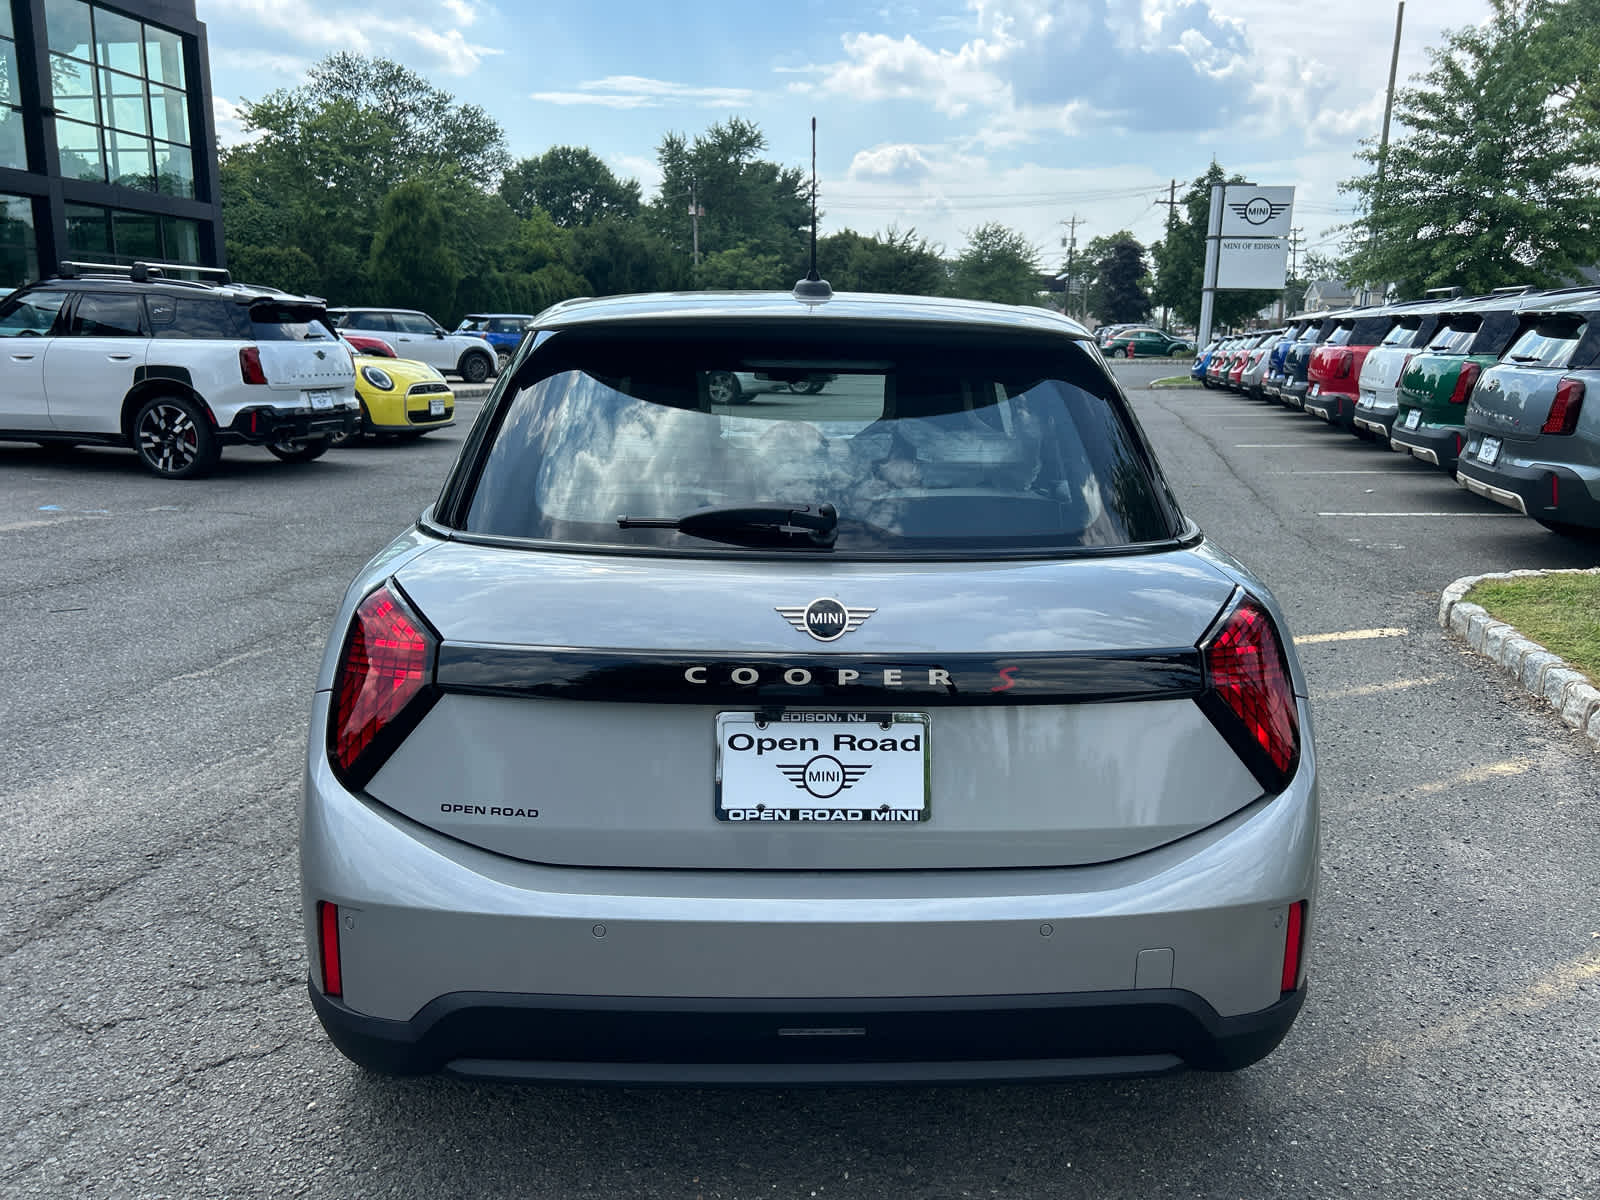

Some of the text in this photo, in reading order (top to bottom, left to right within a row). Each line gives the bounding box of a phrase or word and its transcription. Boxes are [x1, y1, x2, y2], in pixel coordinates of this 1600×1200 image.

[1248, 207, 1269, 216] MINI
[1223, 242, 1281, 250] MINI OF EDISON
[809, 612, 844, 625] MINI
[684, 666, 1020, 692] COOPER S
[781, 712, 867, 723] EDISON, NJ
[727, 733, 921, 755] Open Road
[808, 770, 840, 783] MINI
[440, 803, 539, 818] OPEN ROAD
[728, 809, 920, 822] OPEN ROAD MINI
